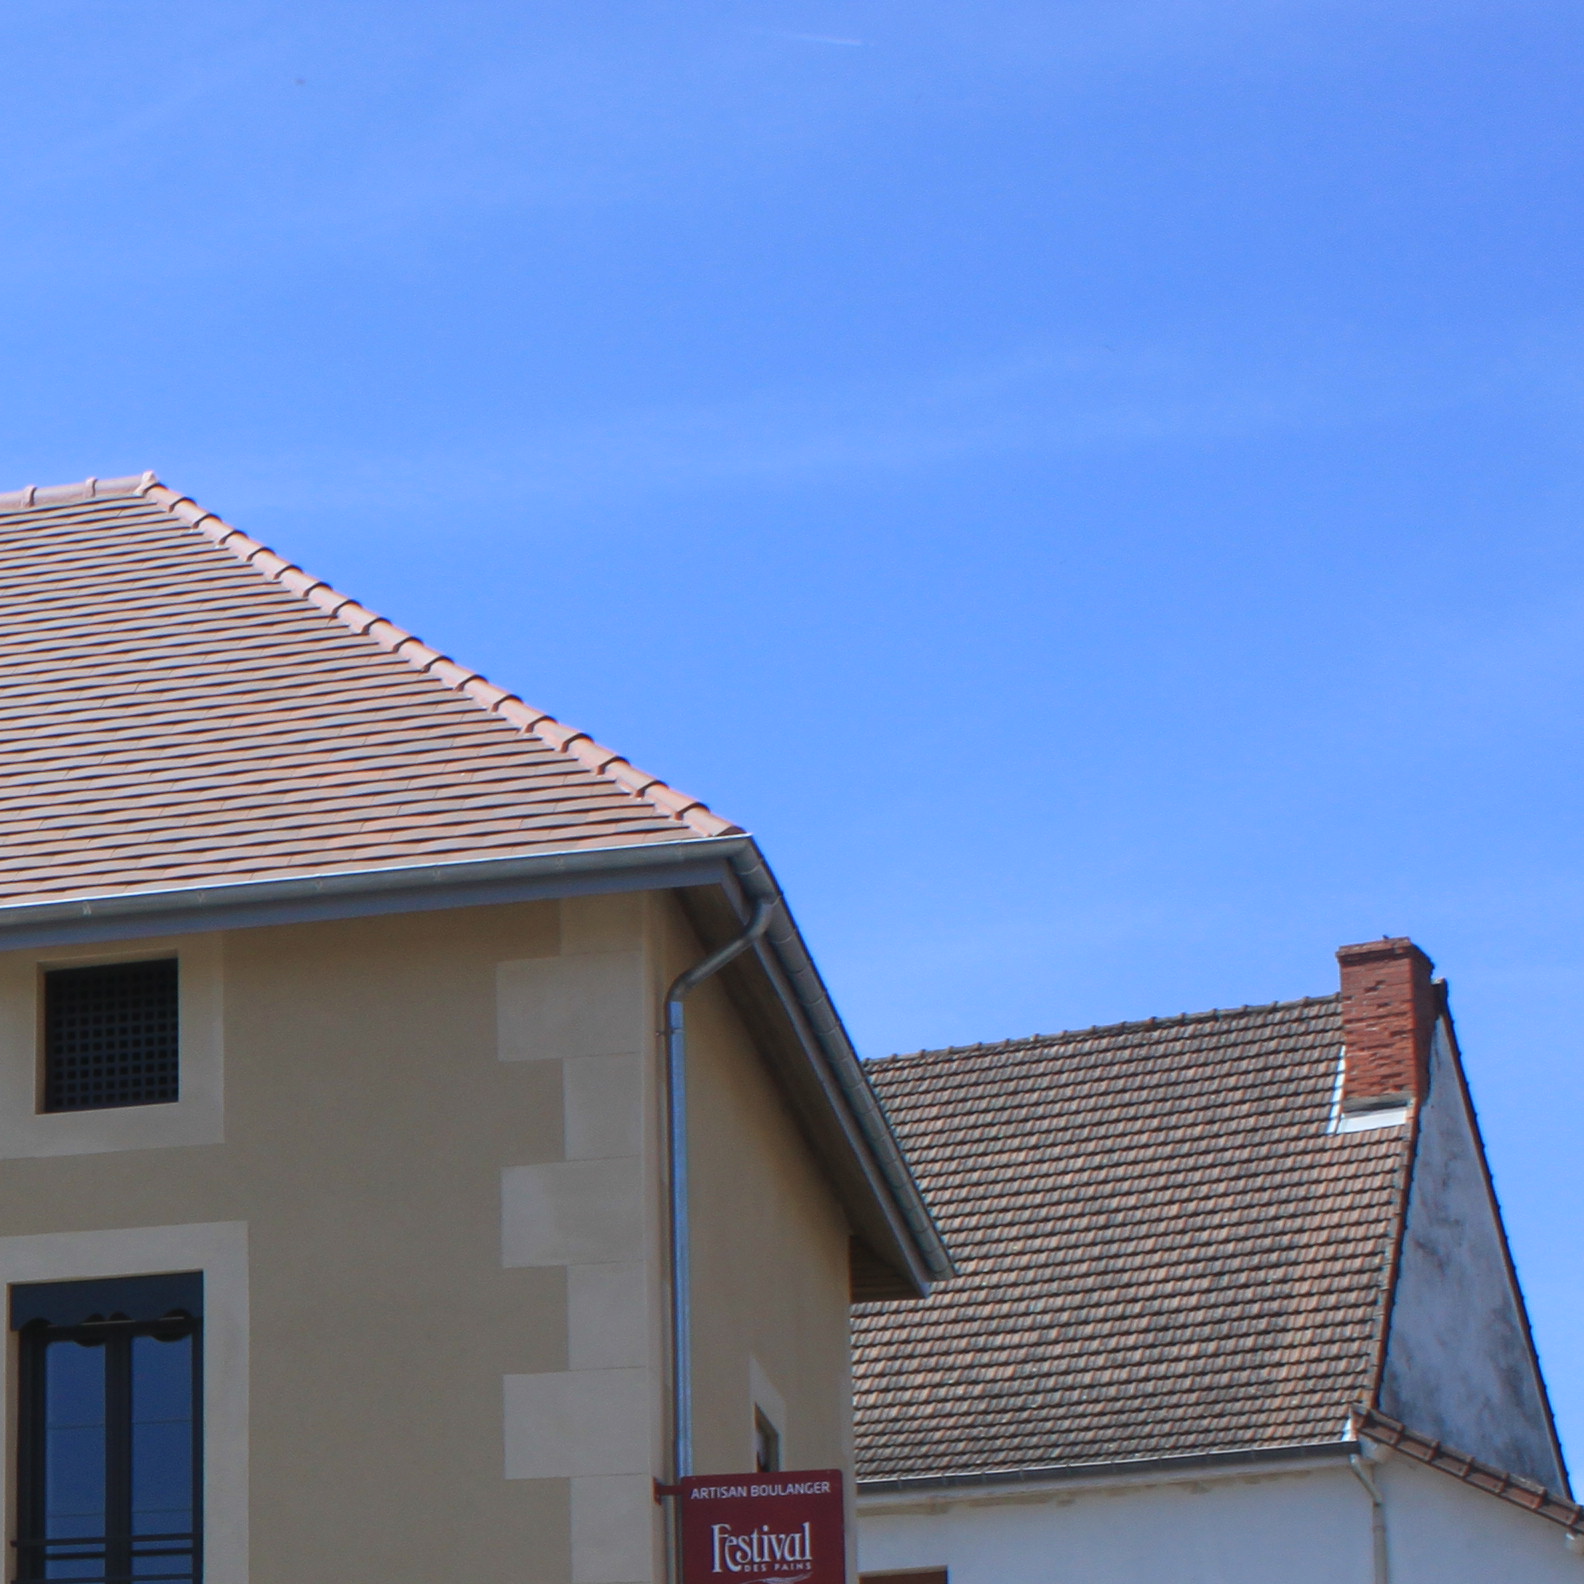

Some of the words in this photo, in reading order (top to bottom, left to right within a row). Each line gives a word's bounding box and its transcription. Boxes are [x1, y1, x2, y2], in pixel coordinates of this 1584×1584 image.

[691, 1485, 747, 1499] ARTISAN
[750, 1481, 831, 1497] BOULANGER
[711, 1521, 813, 1573] Festival
[744, 1564, 767, 1572] DES
[774, 1562, 812, 1571] PAINS
